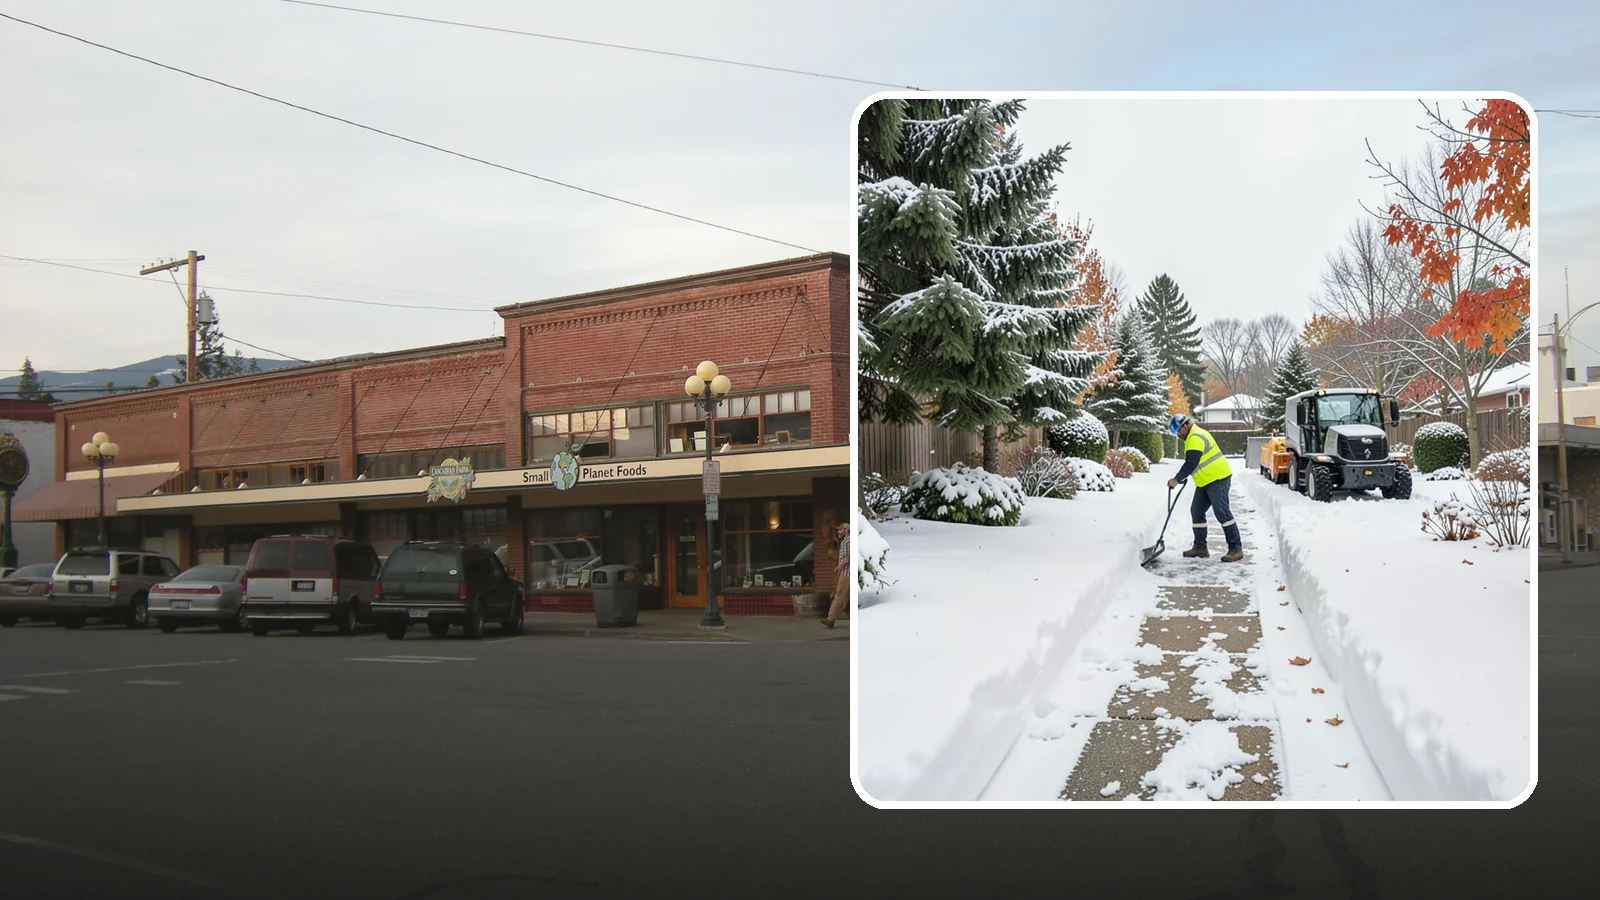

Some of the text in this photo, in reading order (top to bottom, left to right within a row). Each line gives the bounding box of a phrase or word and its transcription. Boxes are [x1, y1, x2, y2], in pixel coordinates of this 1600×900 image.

[523, 465, 647, 483] Small Planet Foods
